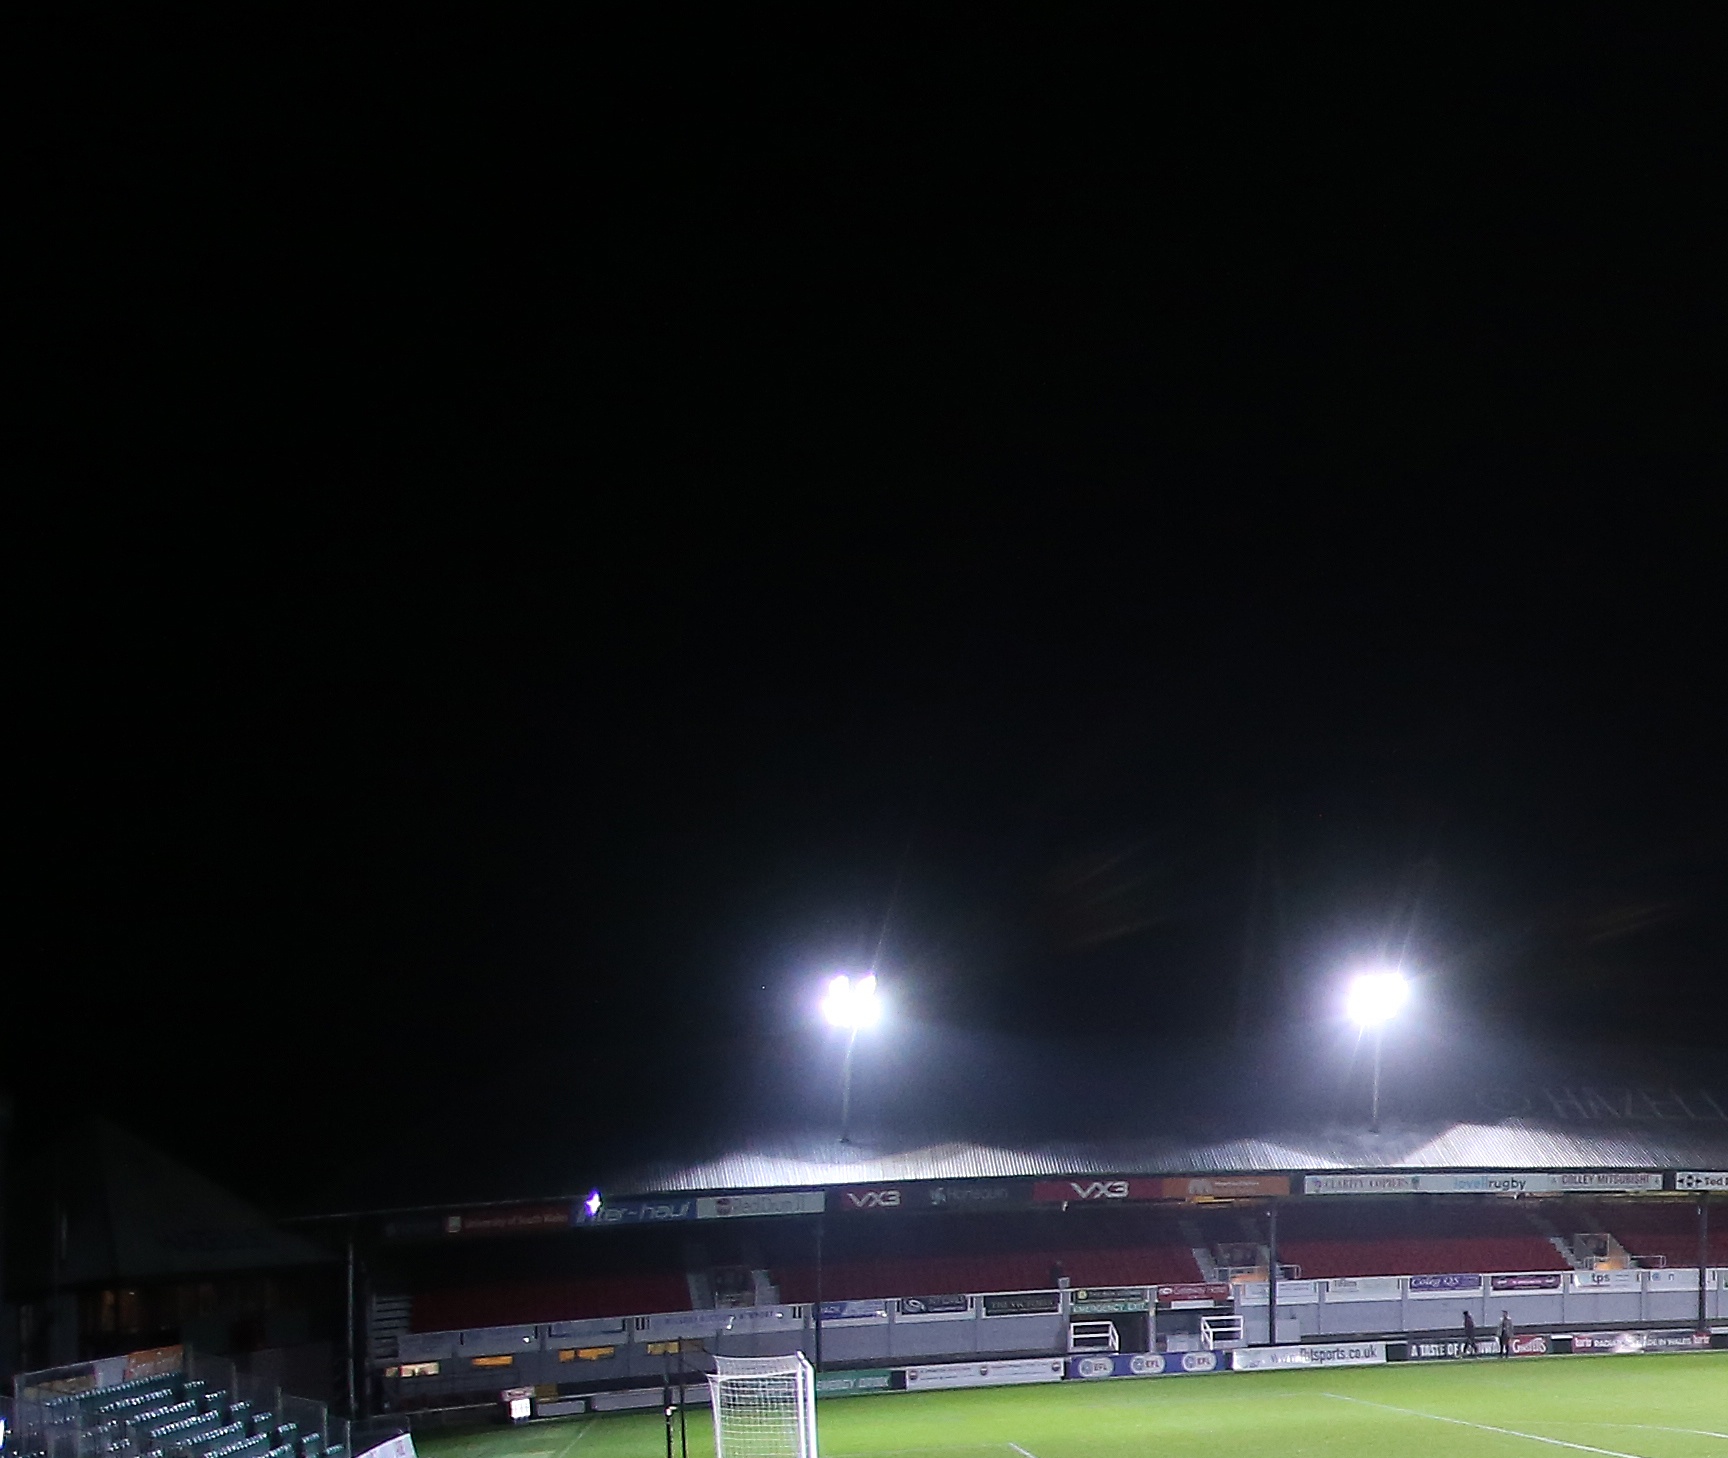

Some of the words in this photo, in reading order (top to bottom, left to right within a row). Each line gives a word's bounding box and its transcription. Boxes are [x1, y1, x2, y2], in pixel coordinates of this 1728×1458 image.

[1489, 1177, 1526, 1191] rugby
[1704, 1177, 1723, 1186] Ted
[1070, 1180, 1129, 1199] VX3
[847, 1189, 902, 1208] VX3
[1592, 1273, 1610, 1284] tps
[1410, 1343, 1419, 1357] A
[1419, 1343, 1446, 1356] TASTE
[1447, 1342, 1459, 1356] OF
[1145, 1358, 1161, 1368] EFL
[1196, 1356, 1211, 1365] EFL
